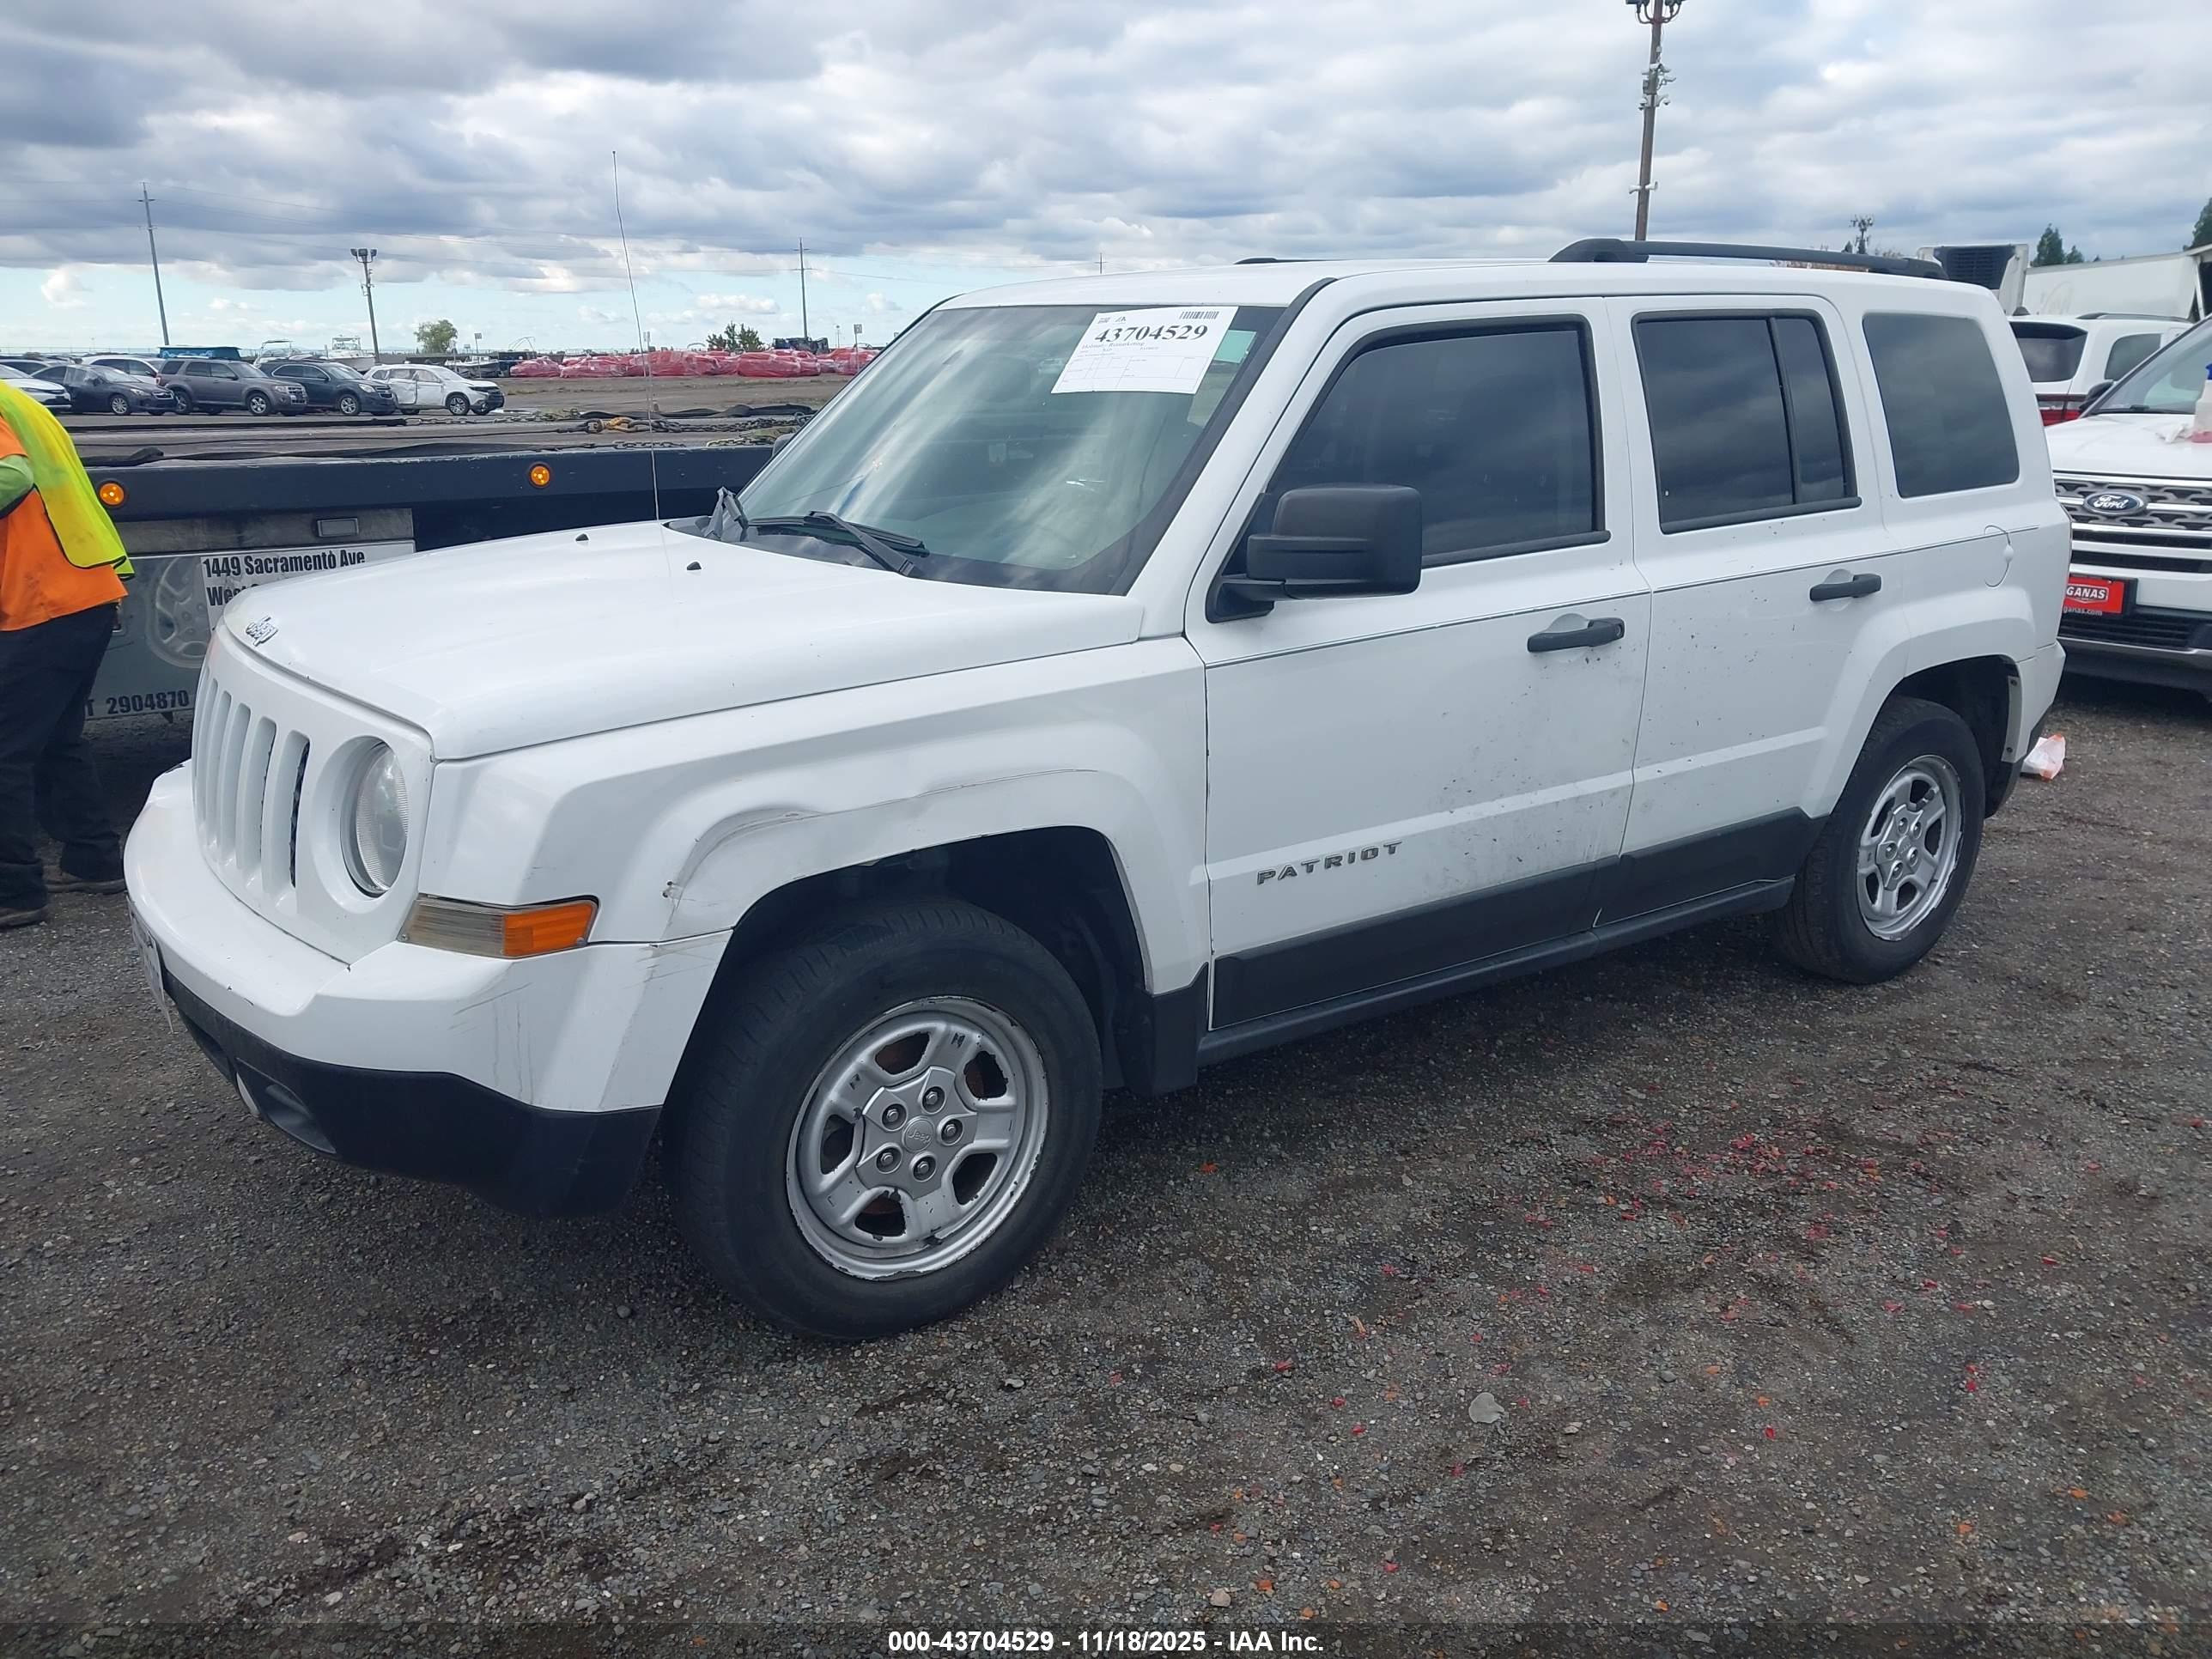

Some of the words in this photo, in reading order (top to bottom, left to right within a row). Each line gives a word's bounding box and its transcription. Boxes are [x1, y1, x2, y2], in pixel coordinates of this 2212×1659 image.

[1095, 325, 1208, 343] 43704529
[2094, 495, 2130, 509] Ford
[203, 556, 241, 577] 1449
[245, 550, 337, 575] Sacramento
[340, 550, 366, 568] Ave
[2066, 586, 2106, 599] GANAS
[106, 690, 189, 714] 2904870
[1256, 840, 1402, 885] PATRIOT
